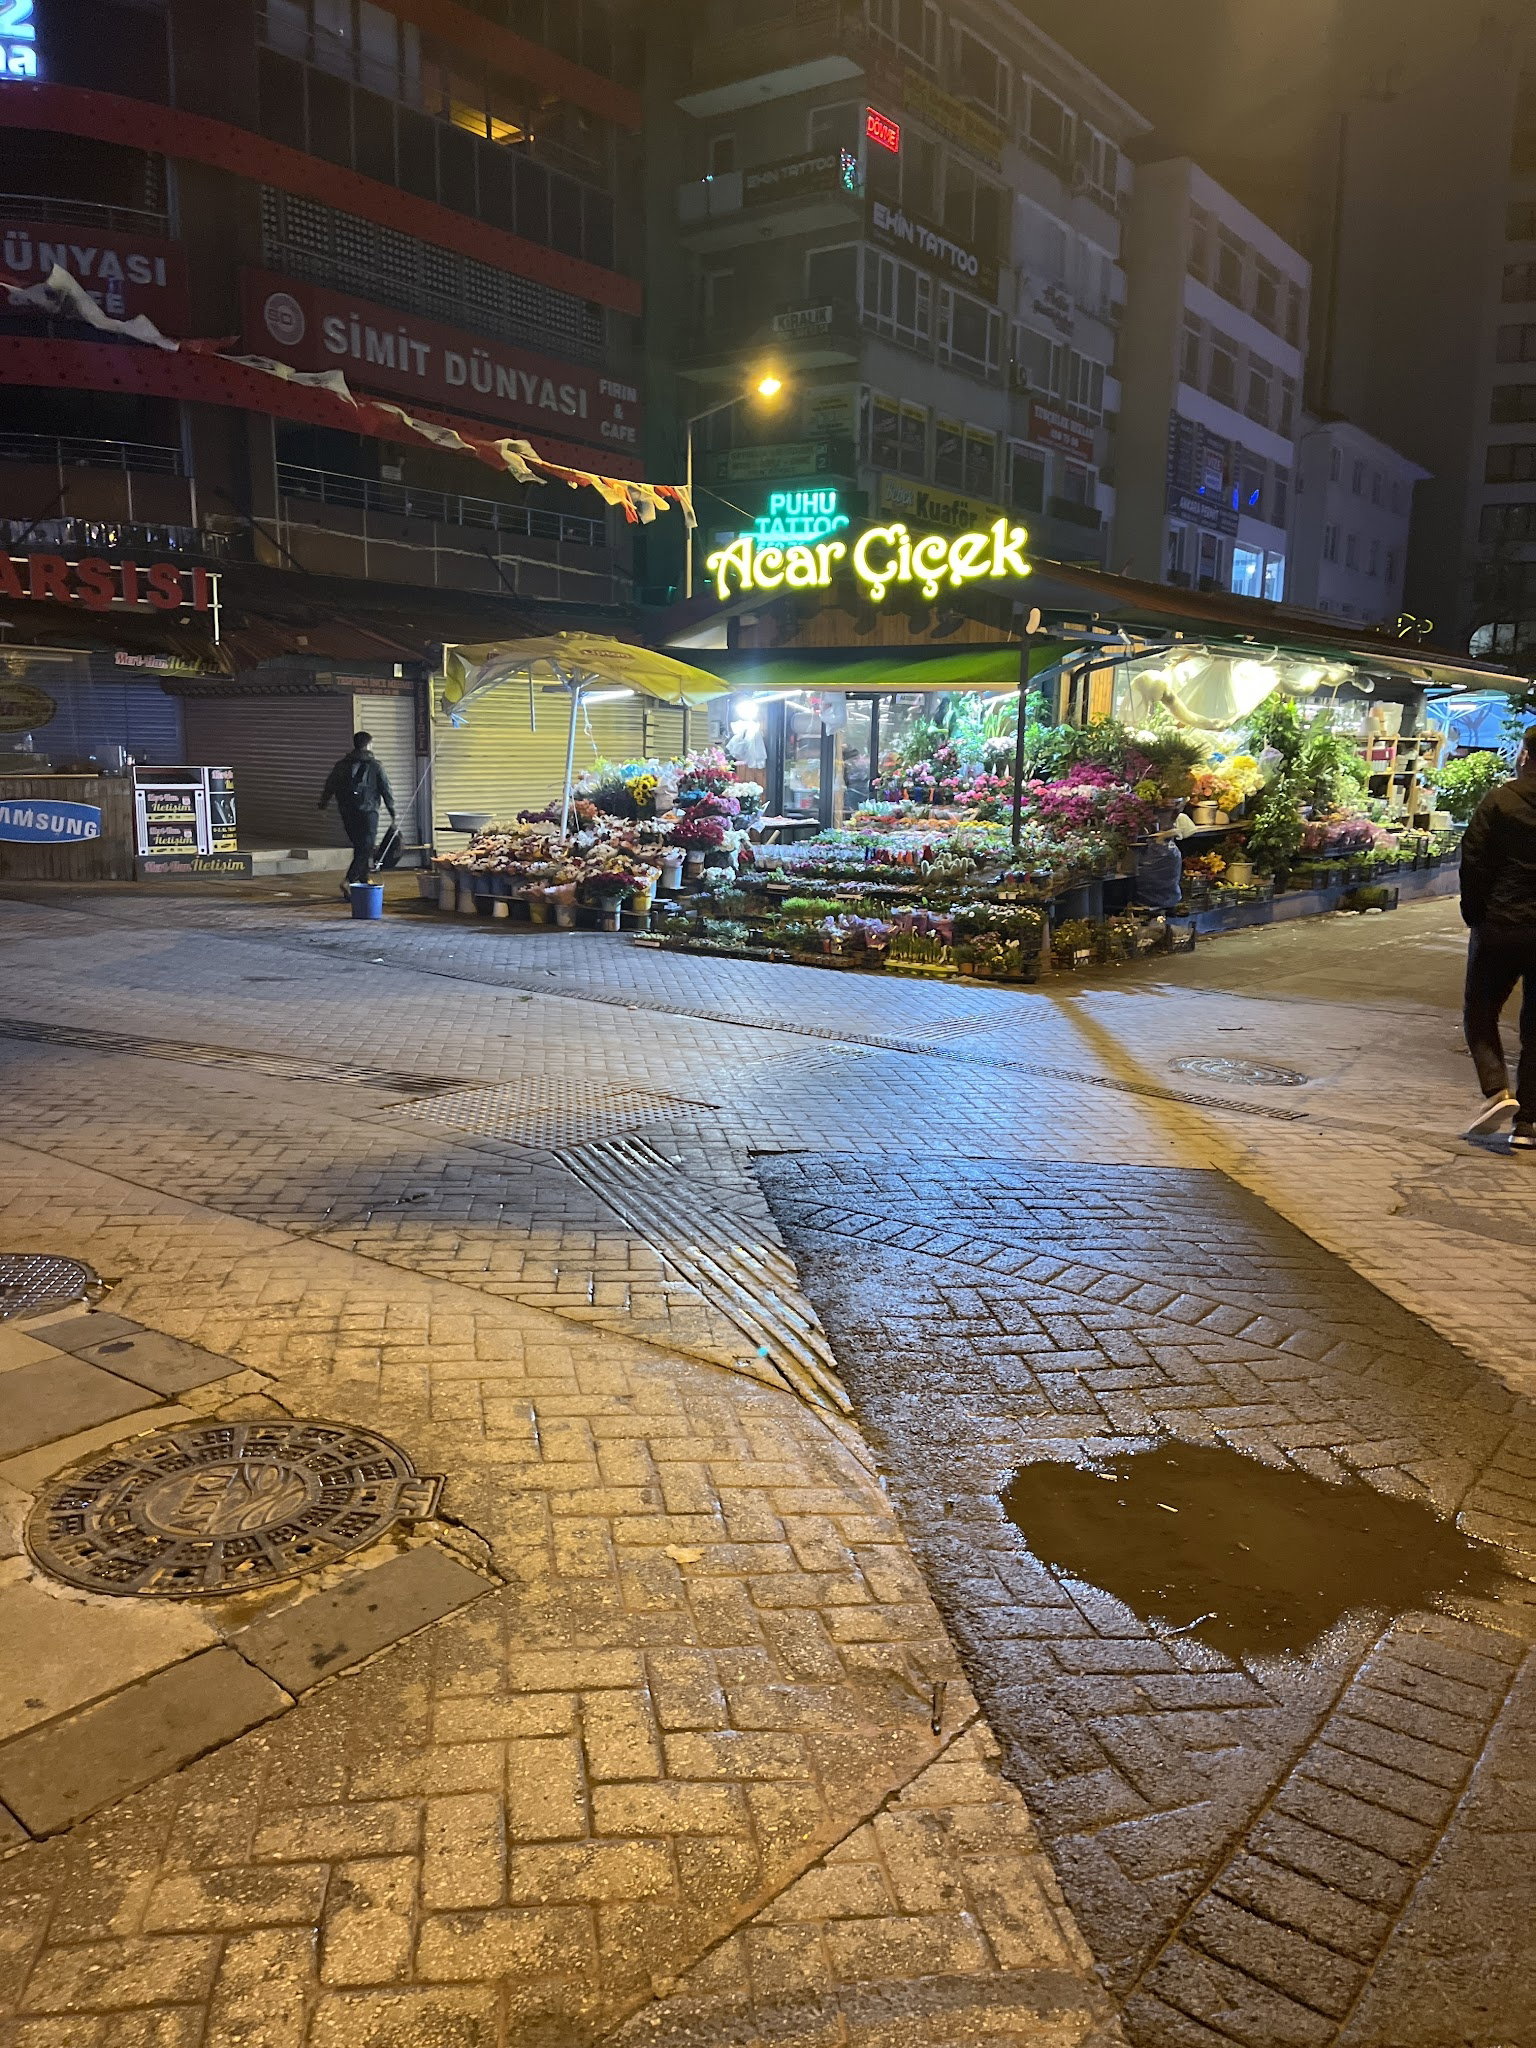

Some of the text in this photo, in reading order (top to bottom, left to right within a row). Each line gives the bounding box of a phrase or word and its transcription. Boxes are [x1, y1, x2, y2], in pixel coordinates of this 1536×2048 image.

[916, 225, 979, 277] TATTOO
[322, 312, 588, 418] SİMİT DÜNYASI
[599, 378, 638, 403] FIRIN
[613, 403, 625, 420] &
[600, 420, 637, 443] CAFE
[769, 491, 837, 516] PUHU
[916, 490, 978, 530] Kuaför
[706, 517, 1033, 600] Acar Çiçek
[190, 856, 245, 874] İletişim
